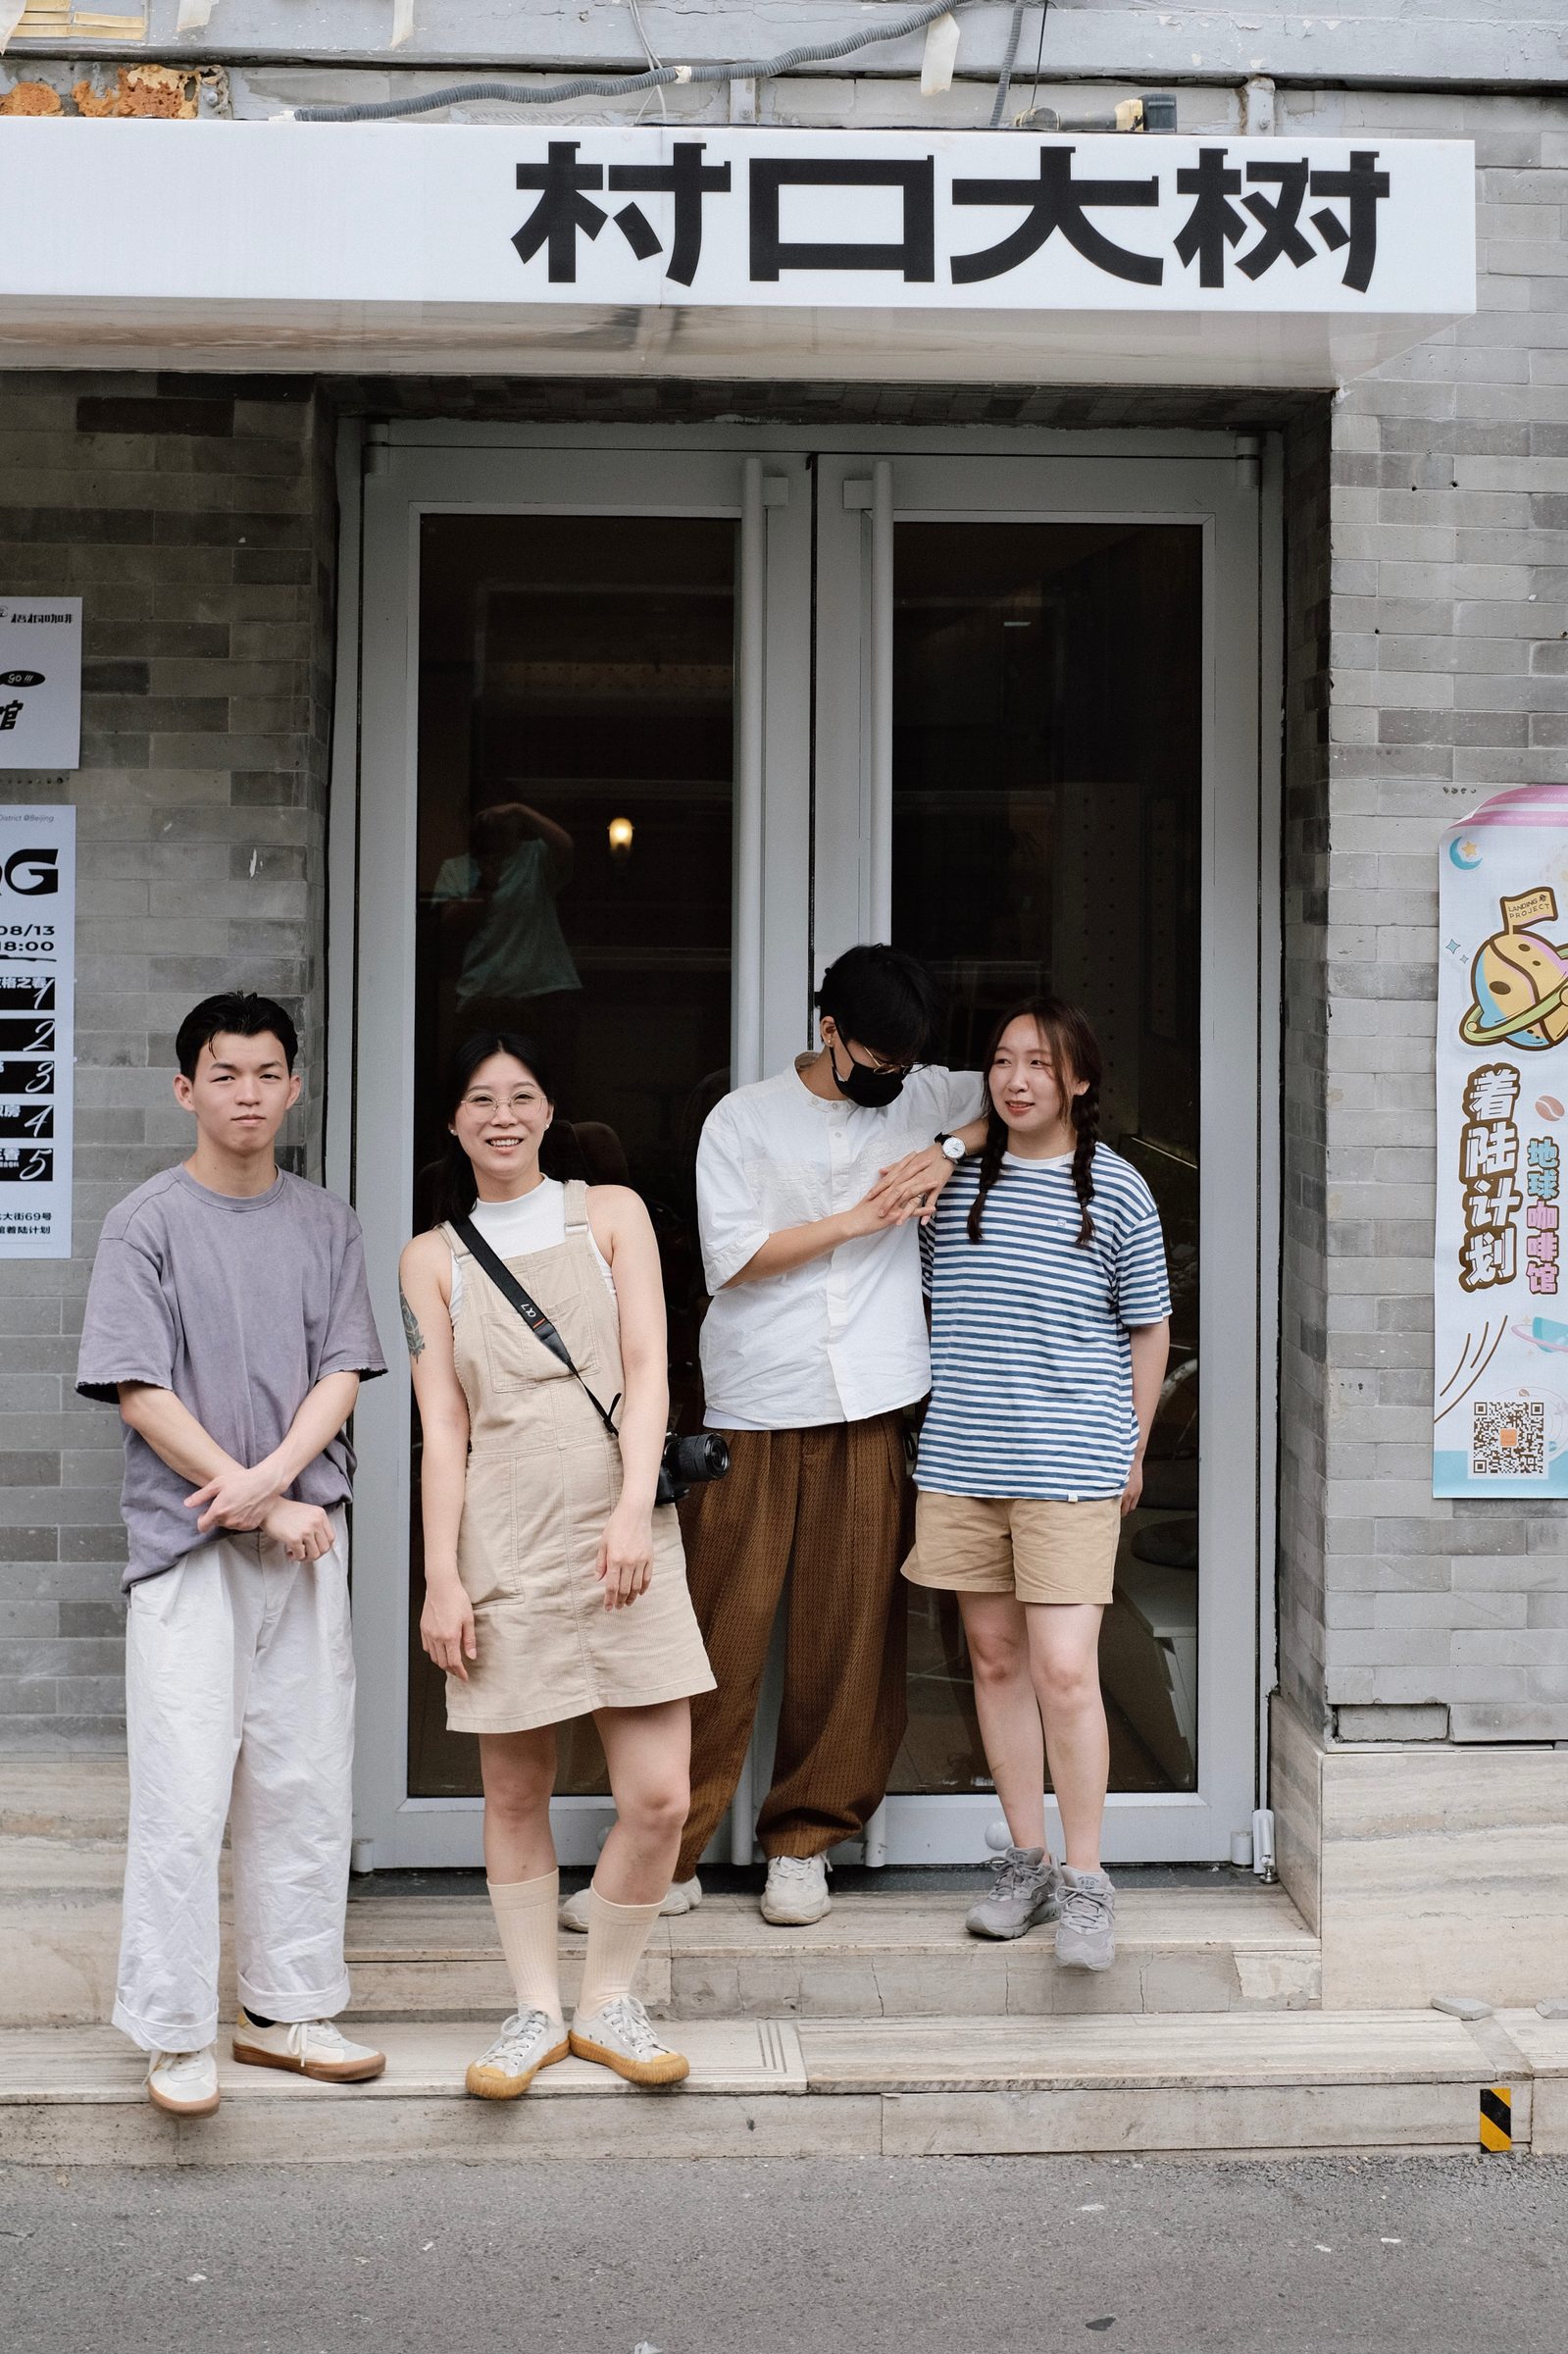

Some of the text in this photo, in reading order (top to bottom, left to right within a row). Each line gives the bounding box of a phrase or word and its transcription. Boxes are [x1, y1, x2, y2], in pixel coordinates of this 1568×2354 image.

[510, 140, 1391, 294] 村口大树
[0, 848, 59, 896] G
[1507, 897, 1539, 912] LANDING
[1509, 903, 1550, 919] PROJECT
[0, 941, 55, 951] 8:00
[23, 1020, 55, 1051] 2
[25, 1061, 54, 1094] 3
[24, 1105, 54, 1138] 4
[19, 1149, 53, 1181] 5
[1461, 1064, 1522, 1291] 着陆计划
[1526, 1137, 1560, 1295] 地球咖啡馆
